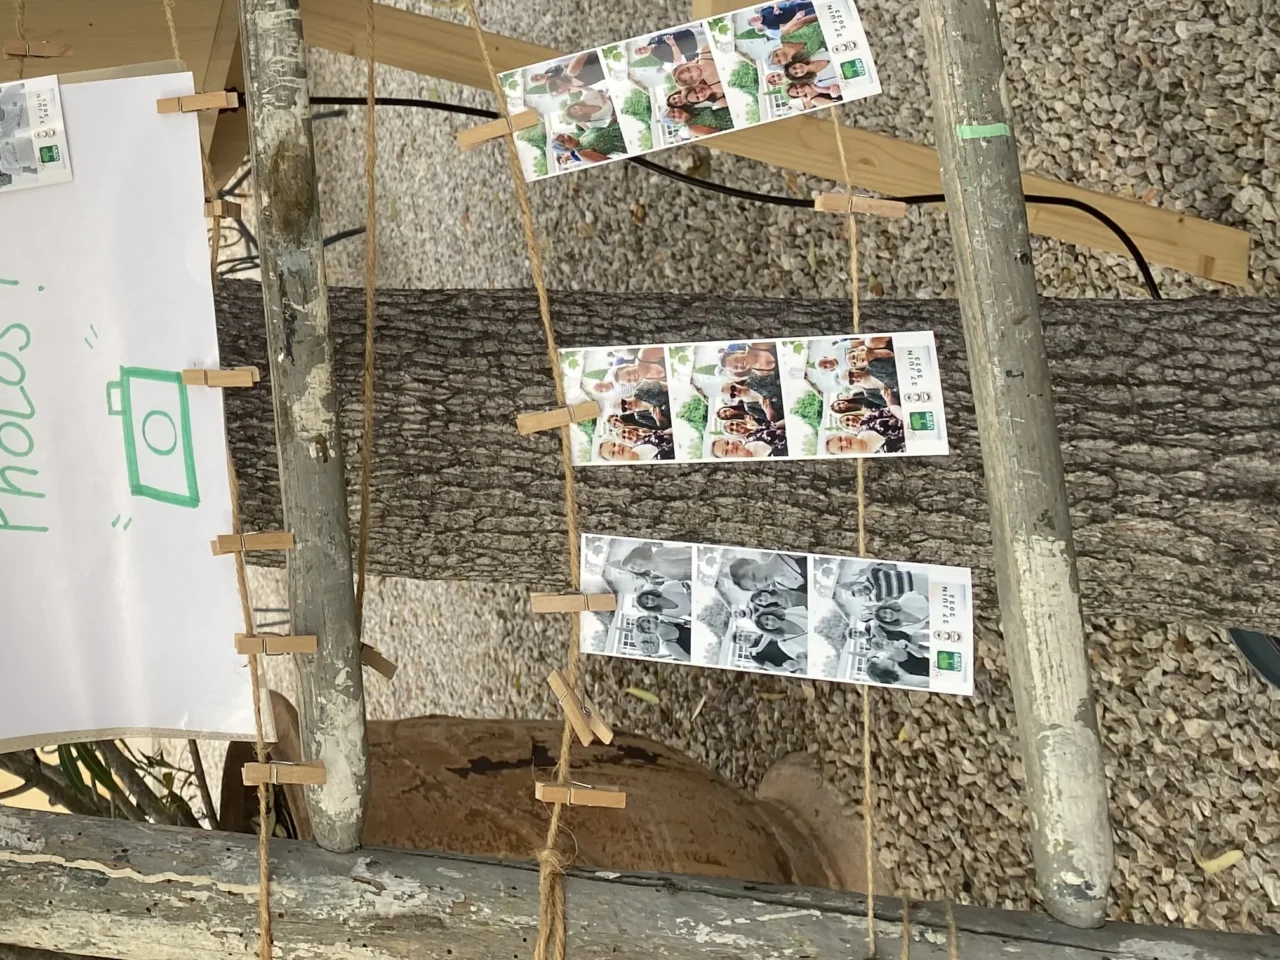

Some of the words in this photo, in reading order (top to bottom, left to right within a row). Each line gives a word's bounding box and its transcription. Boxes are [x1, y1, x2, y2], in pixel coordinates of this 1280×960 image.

[826, 4, 838, 24] JUIN
[907, 350, 916, 371] JUIN
[915, 357, 923, 378] 2023
[911, 376, 918, 386] 27
[942, 613, 949, 624] 27
